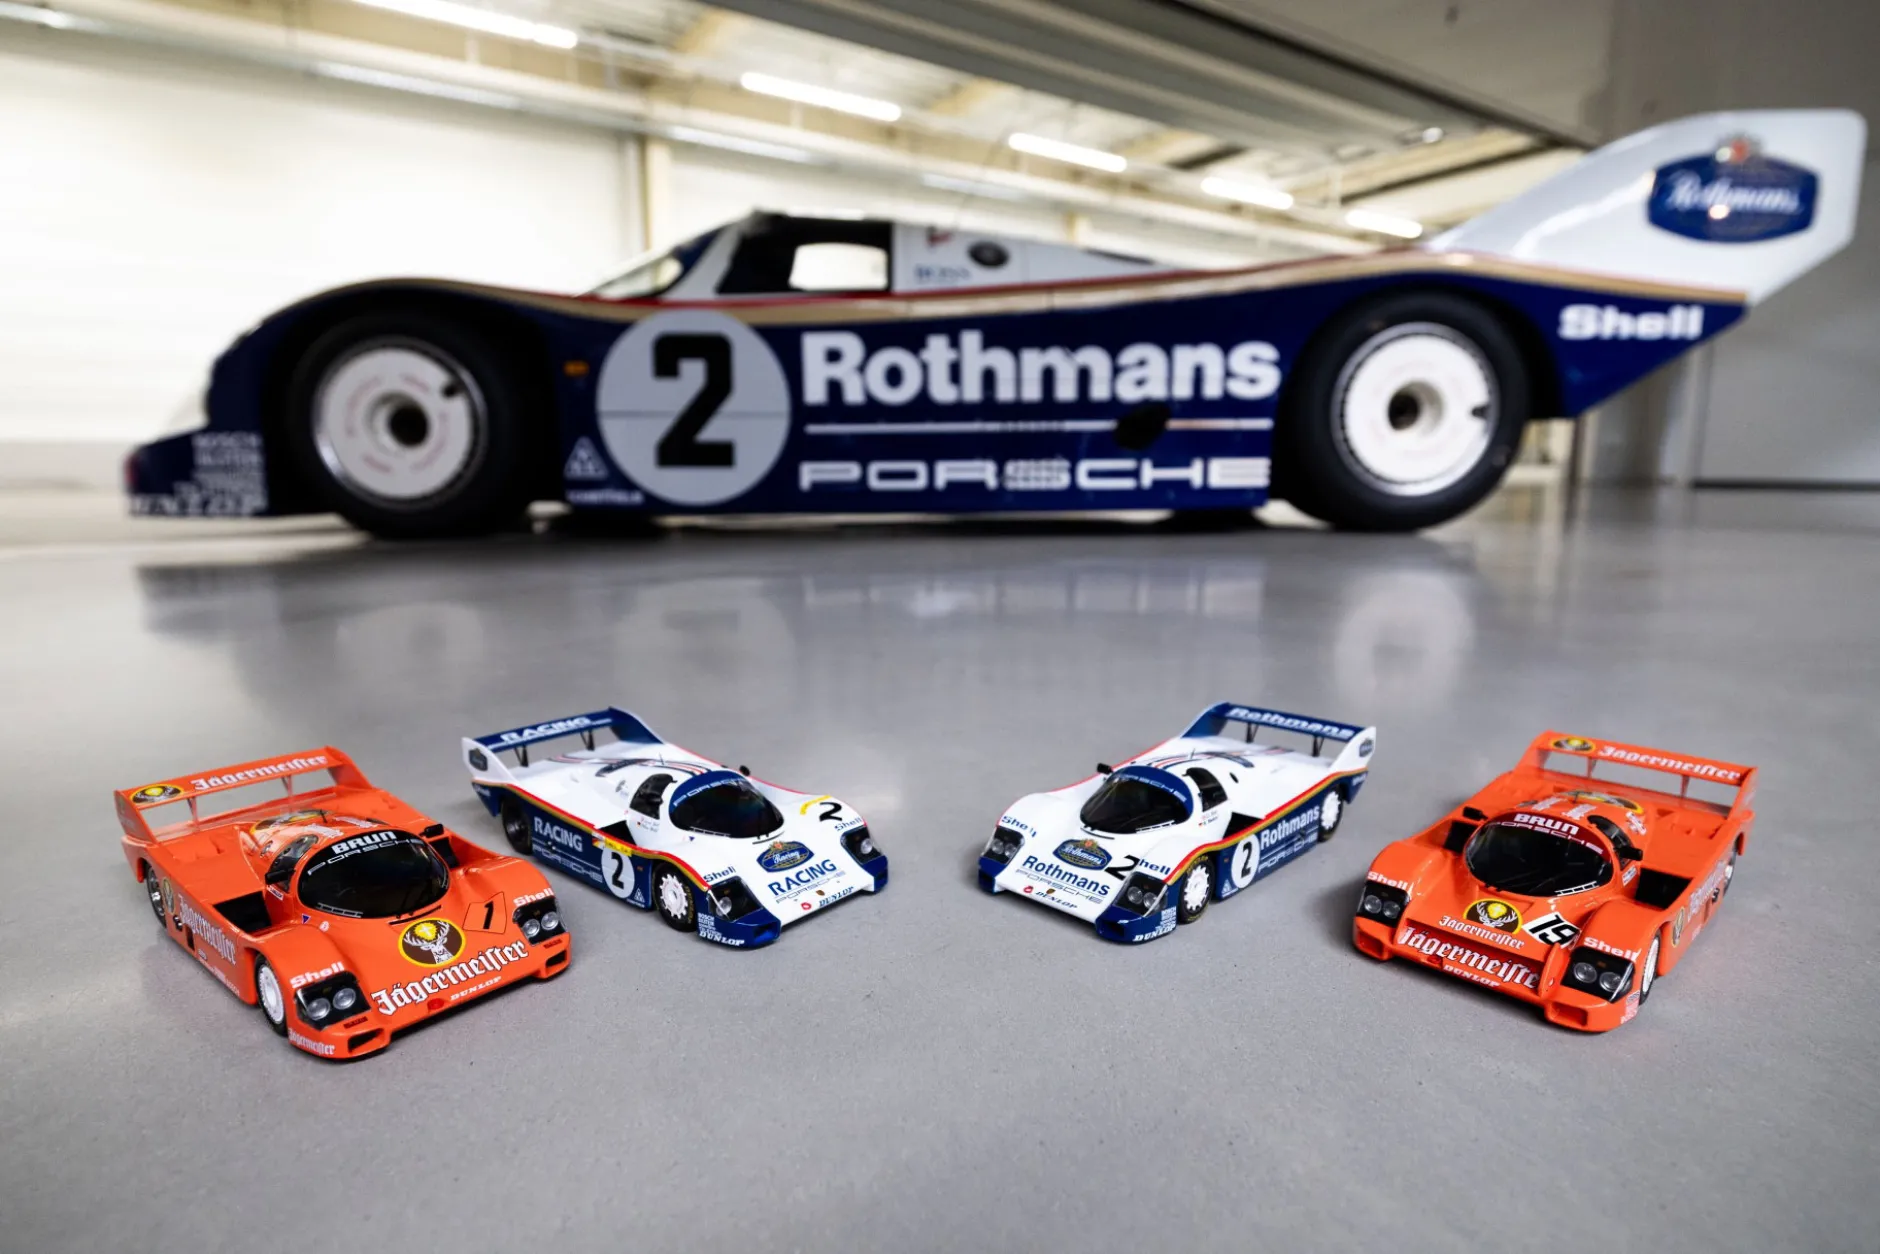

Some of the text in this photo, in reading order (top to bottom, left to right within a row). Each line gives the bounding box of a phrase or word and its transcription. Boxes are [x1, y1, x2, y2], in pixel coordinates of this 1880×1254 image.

[1557, 303, 1705, 341] Shell
[801, 329, 1282, 406] Rothmans
[652, 330, 736, 469] 2
[799, 457, 1272, 491] PORSCHE
[500, 716, 592, 743] RACING
[1225, 707, 1356, 741] Rothmans
[818, 801, 843, 822] 2
[834, 817, 866, 832] Shell
[1513, 813, 1580, 836] BRUN
[533, 816, 584, 853] RACING
[1260, 805, 1320, 851] Rothmans
[331, 831, 398, 855] BRUN
[772, 849, 800, 864] Racing
[611, 851, 625, 890] 2
[1104, 854, 1141, 881] 2
[1139, 859, 1172, 876] hell
[1241, 841, 1253, 879] 2
[703, 865, 736, 883] Shell
[768, 859, 837, 896] RACING
[1022, 855, 1111, 897] Rothmans
[1367, 871, 1409, 890] Shell
[513, 887, 555, 907] Shell
[818, 886, 855, 907] DUNLOP
[483, 901, 495, 930] 1
[698, 929, 745, 947] DUNLOP
[1132, 922, 1177, 942] DUNLOP
[1528, 914, 1580, 947] 19
[1583, 936, 1638, 962] Shell
[289, 961, 346, 989] Shell
[371, 938, 529, 1016] Jägermeister
[450, 975, 502, 1001] DUNLOP
[1443, 964, 1501, 988] DUNLOP
